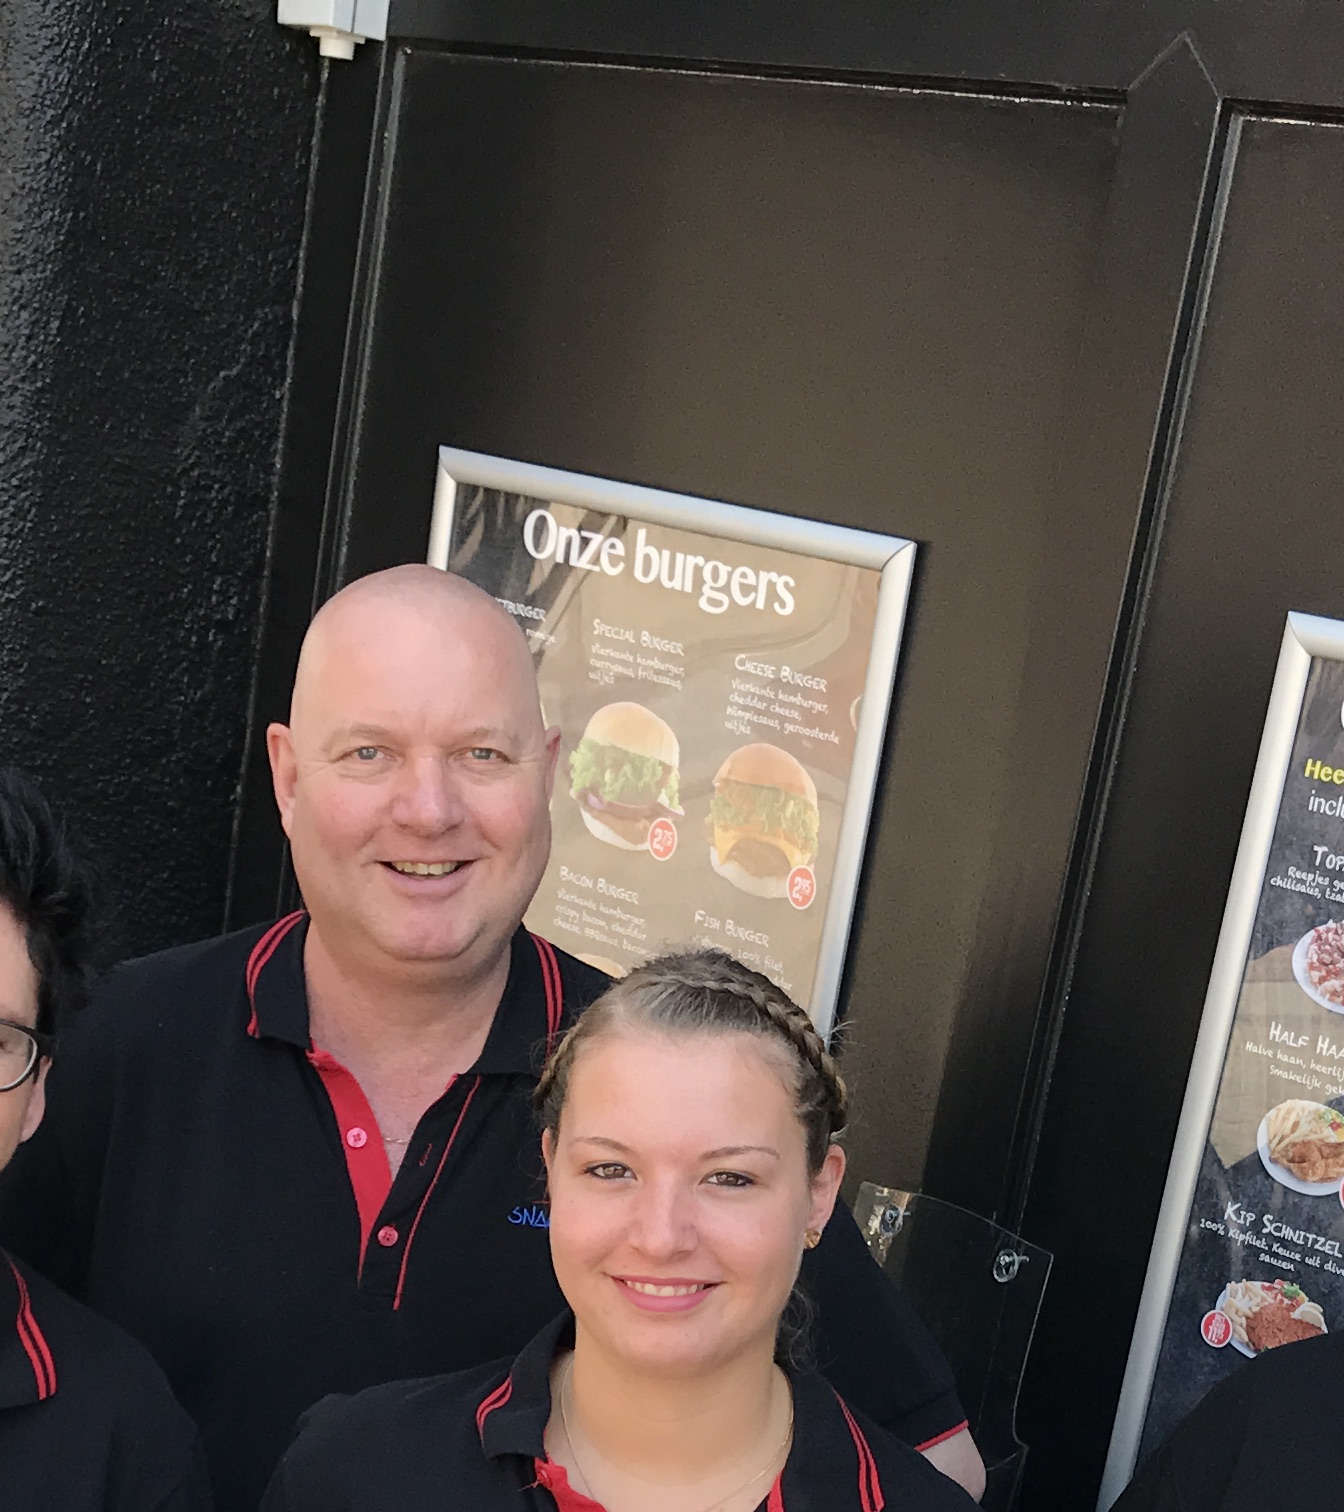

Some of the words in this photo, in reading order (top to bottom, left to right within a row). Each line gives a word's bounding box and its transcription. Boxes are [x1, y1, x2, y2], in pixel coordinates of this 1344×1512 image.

[522, 508, 626, 577] Onze
[632, 528, 797, 617] burgers
[1270, 875, 1323, 901] chilisaus,
[1287, 865, 1330, 887] Reepjes
[1245, 1041, 1274, 1059] Halve
[1276, 1050, 1307, 1069] haan,
[1269, 1065, 1322, 1090] Smakelijk
